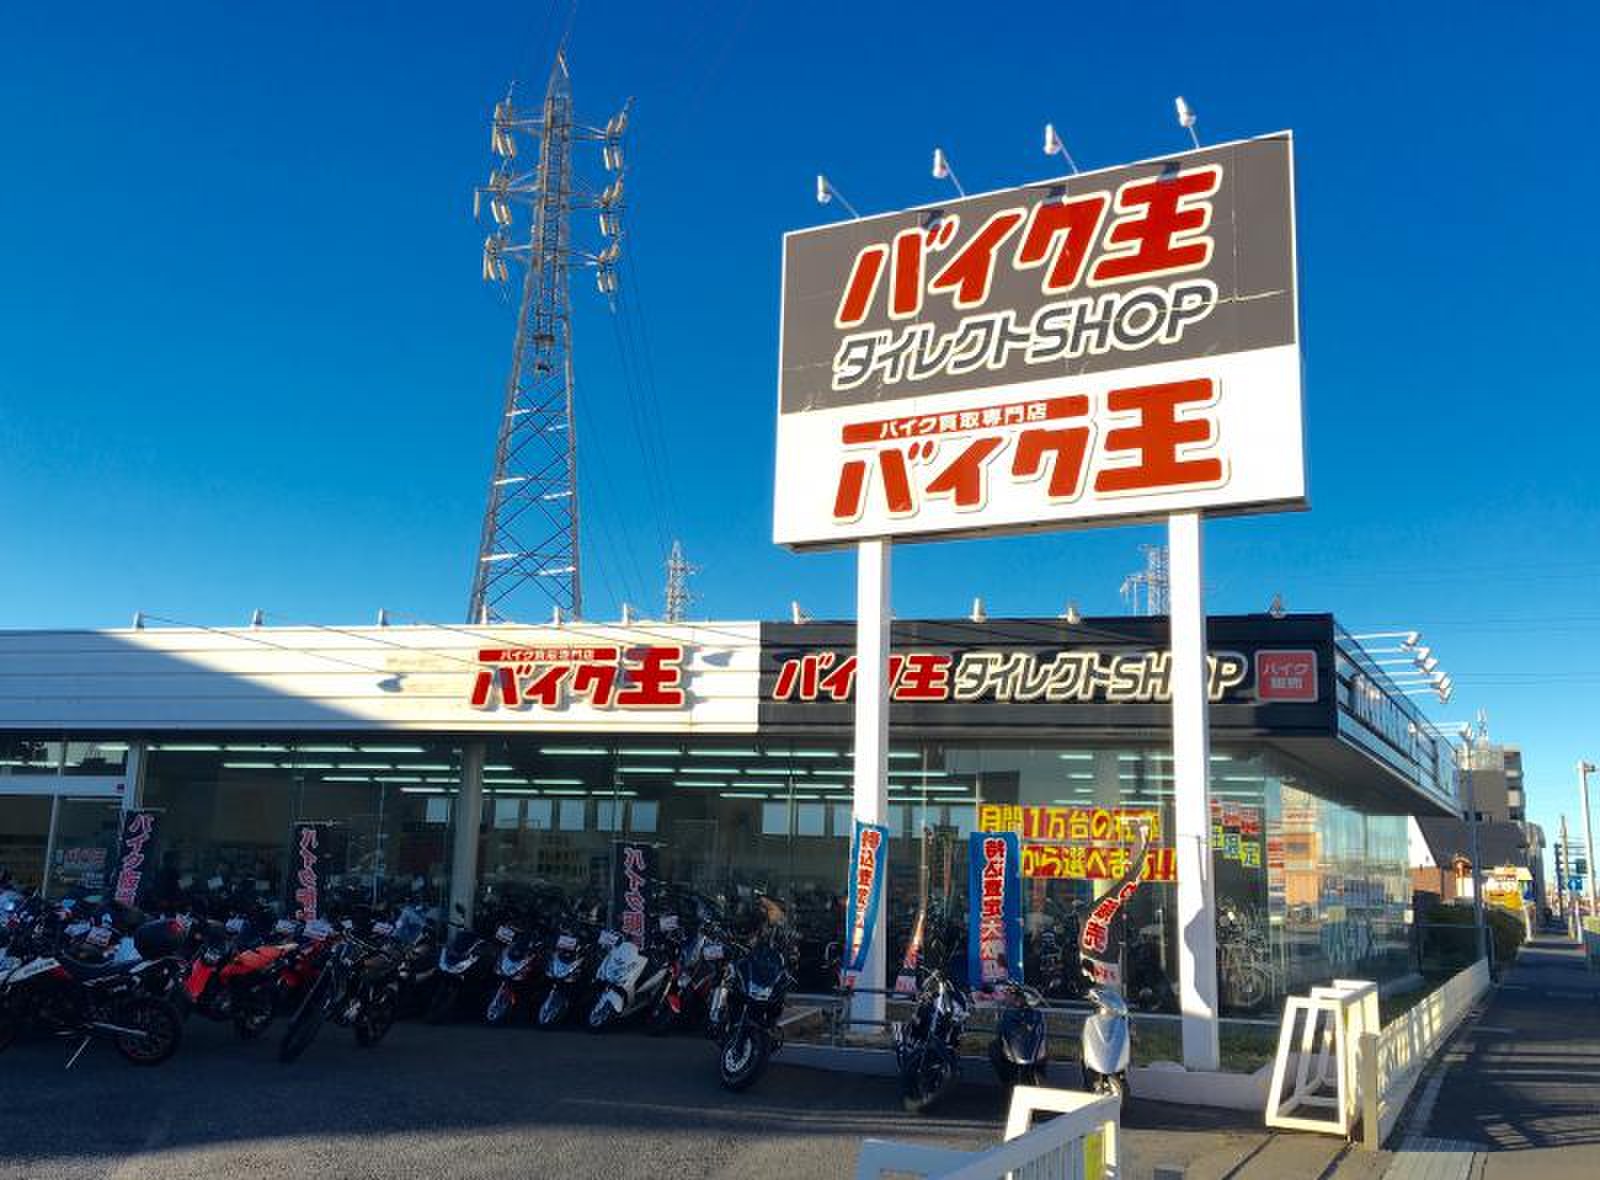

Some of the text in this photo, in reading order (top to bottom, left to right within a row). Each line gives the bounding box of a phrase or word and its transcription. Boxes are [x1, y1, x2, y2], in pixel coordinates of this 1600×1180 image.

[836, 166, 1222, 328] バイク王
[832, 279, 1217, 390] ダイレクトSHOP
[832, 378, 1226, 519] バイク王
[879, 403, 1048, 439] バイク買取専門店
[470, 646, 684, 705] バイク王
[954, 652, 1247, 700] ダイレクトSHP
